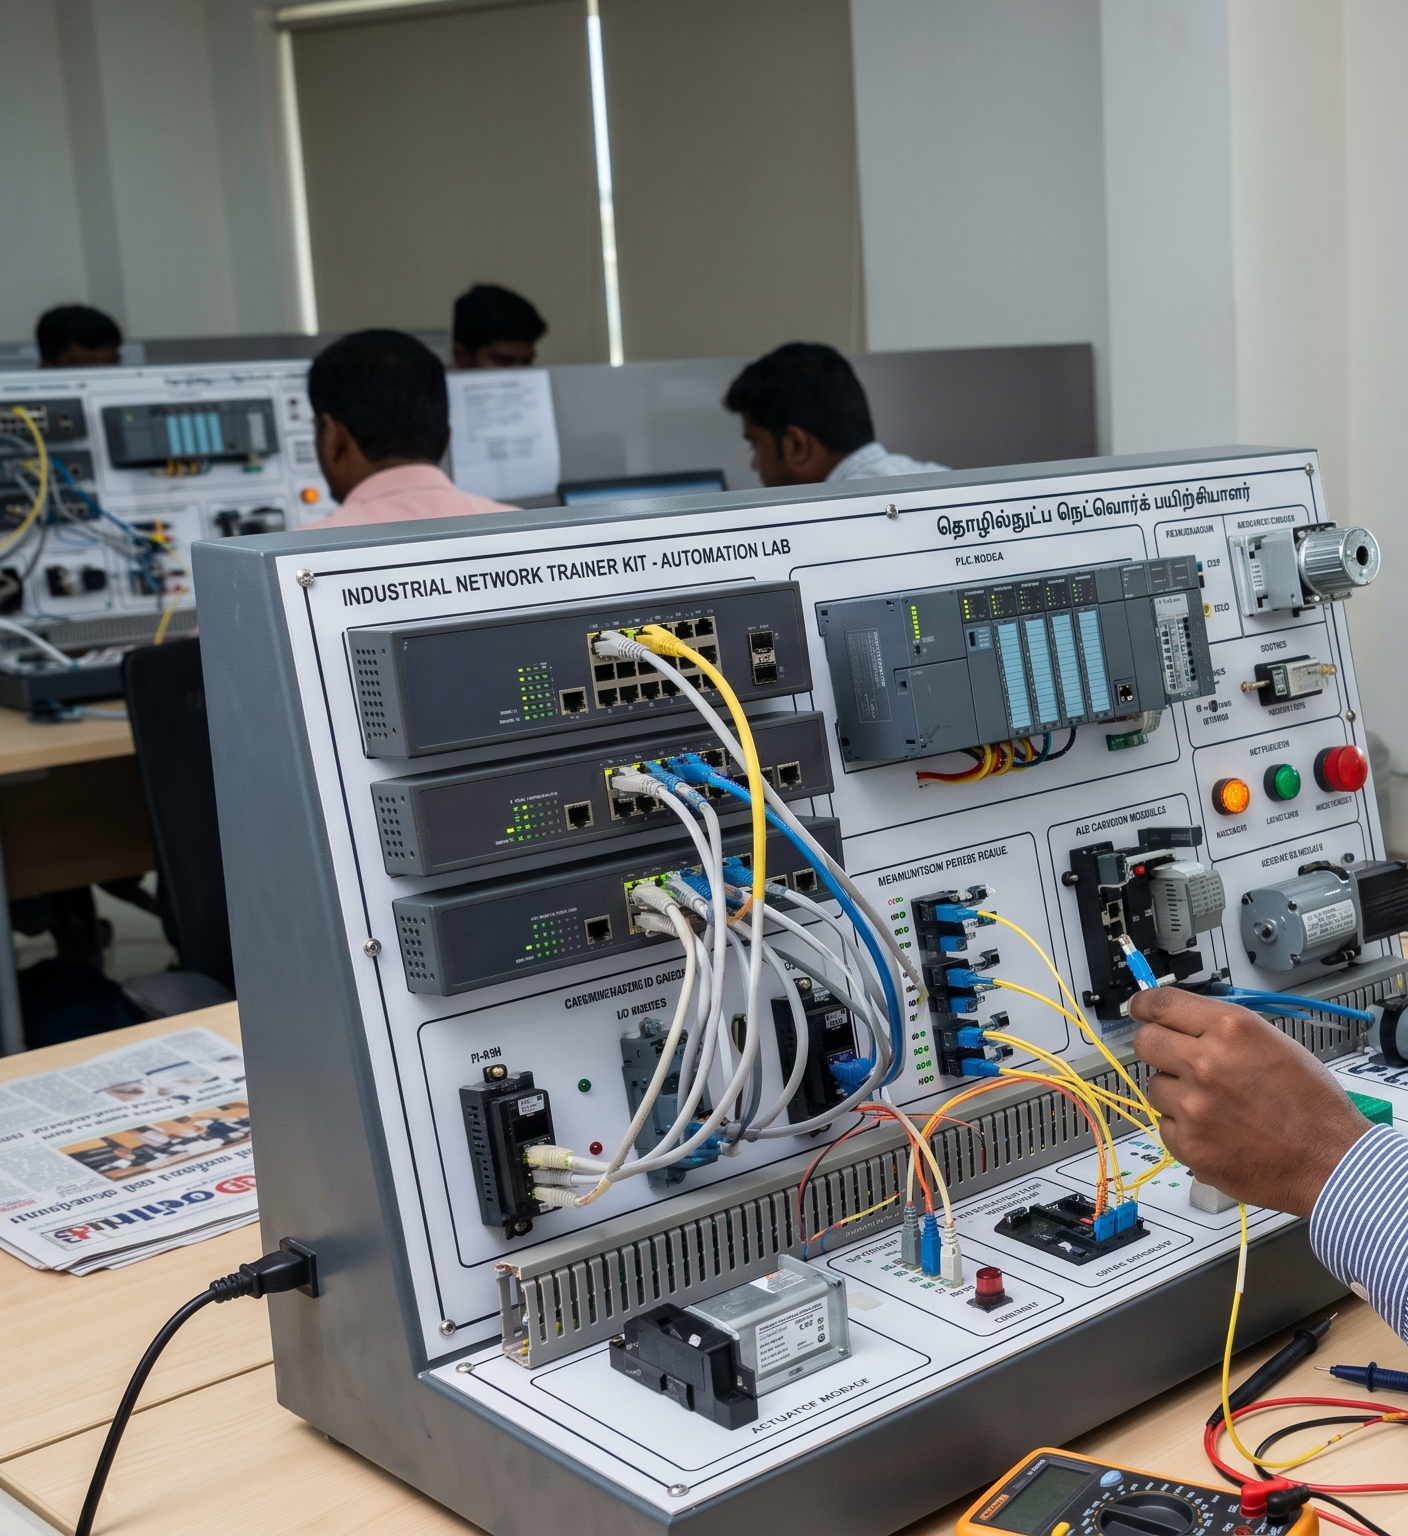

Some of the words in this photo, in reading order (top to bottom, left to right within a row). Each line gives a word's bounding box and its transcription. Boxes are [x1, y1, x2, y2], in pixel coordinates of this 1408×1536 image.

[341, 577, 452, 607] INDUSTRIAL
[456, 566, 544, 593] NETWORK
[547, 557, 618, 582] TRAINER
[622, 554, 647, 574] KIT
[660, 542, 759, 569] AUTOMATION
[762, 538, 791, 557] LAB
